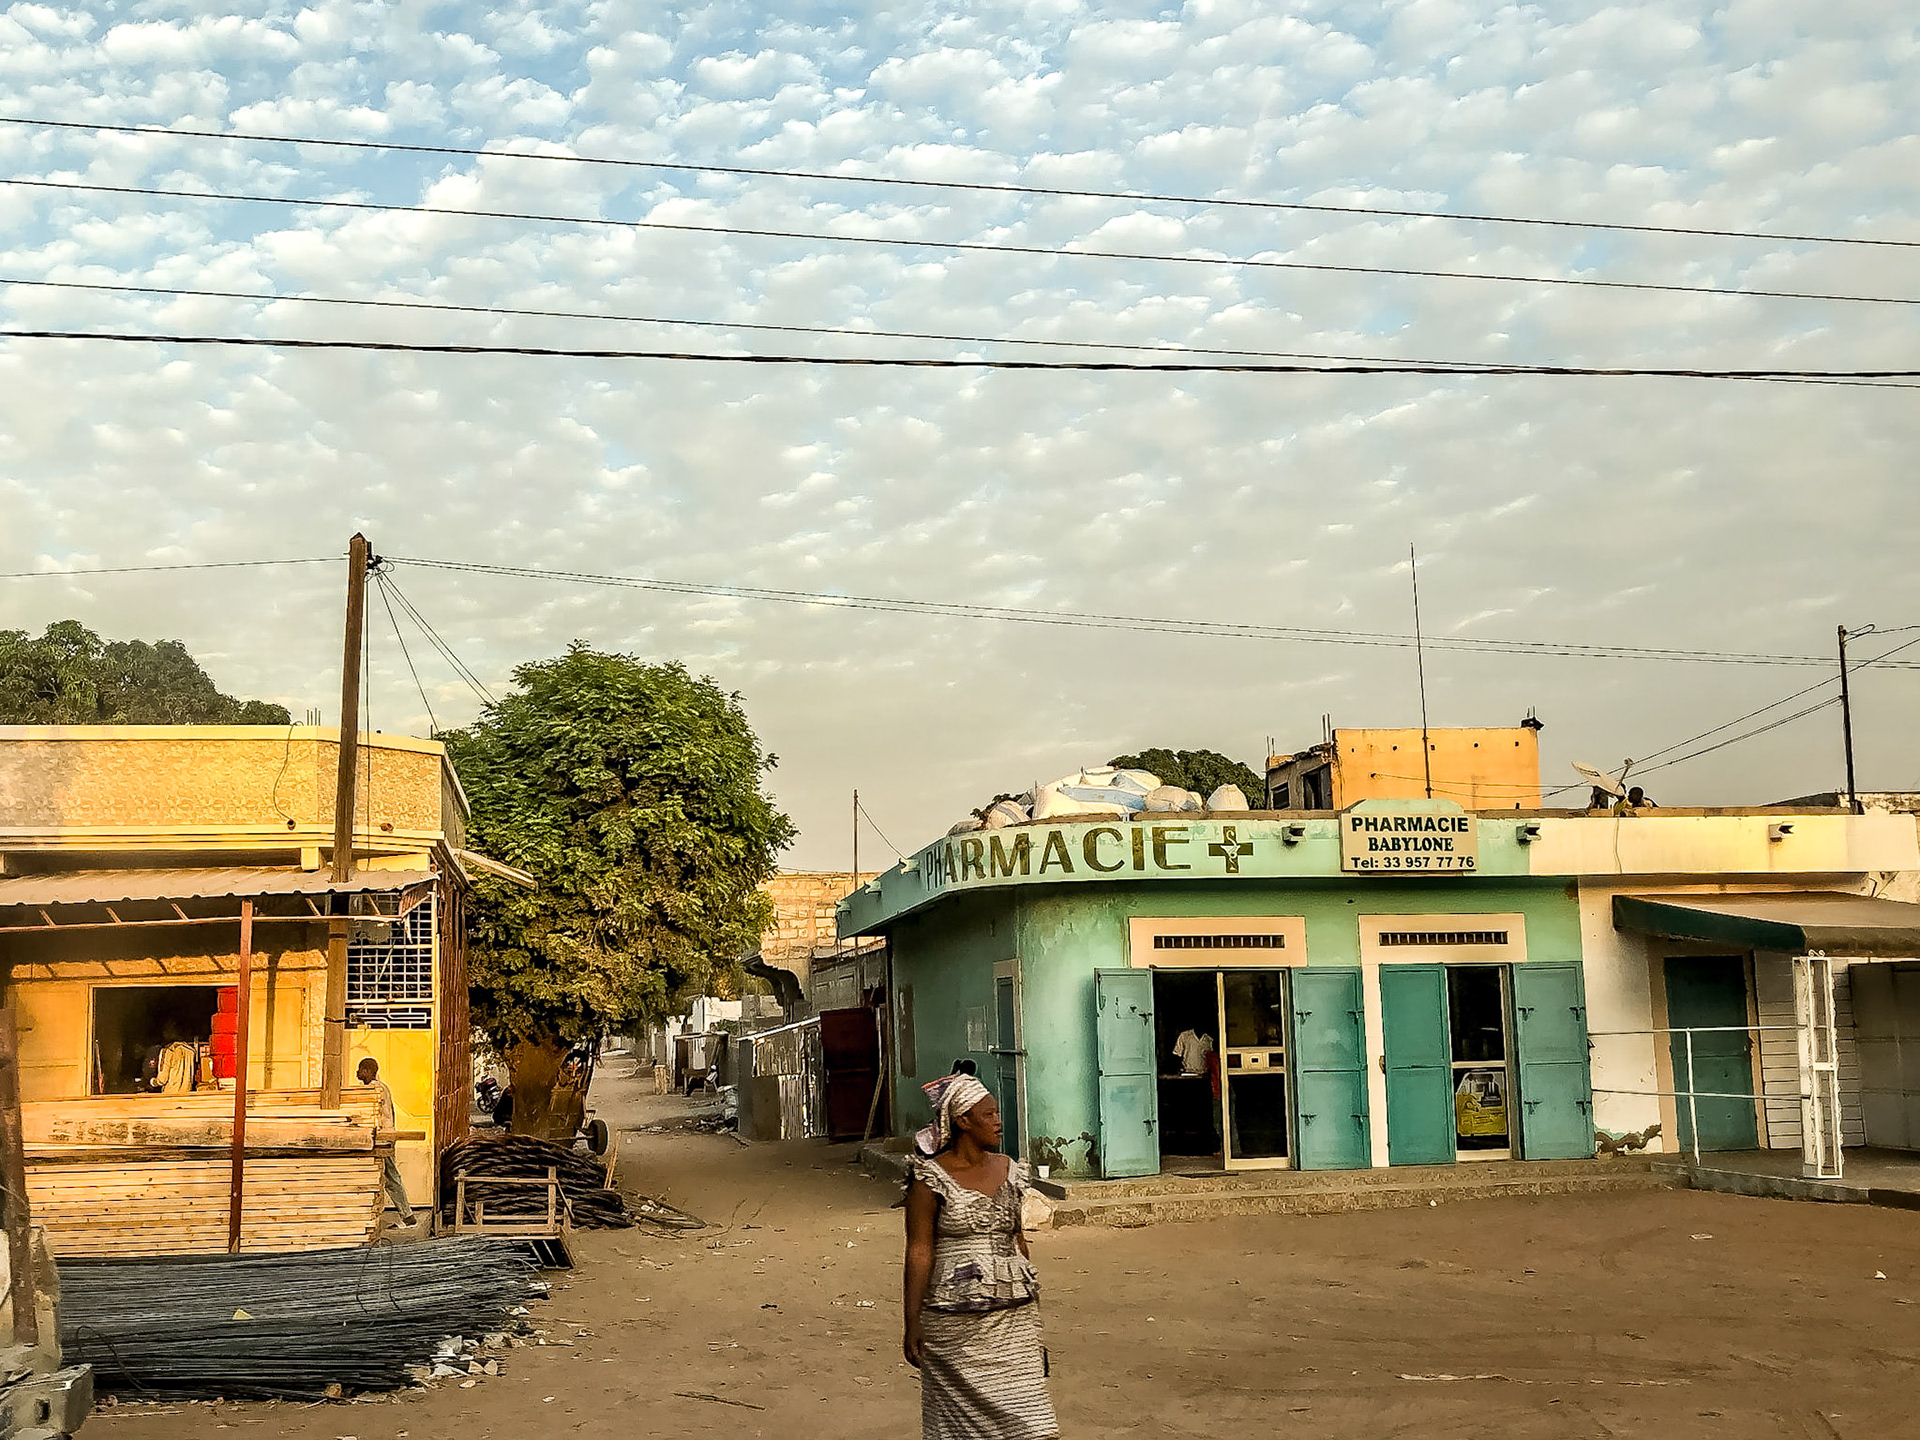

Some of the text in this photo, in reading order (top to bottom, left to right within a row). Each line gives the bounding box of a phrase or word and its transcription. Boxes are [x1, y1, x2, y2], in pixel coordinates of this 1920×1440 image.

[1351, 817, 1469, 832] PHARMACIE
[1367, 837, 1454, 851] BABYLONE
[926, 826, 1191, 891] PHARMACIE
[1351, 856, 1475, 868] Tel: 33 957 77 76
